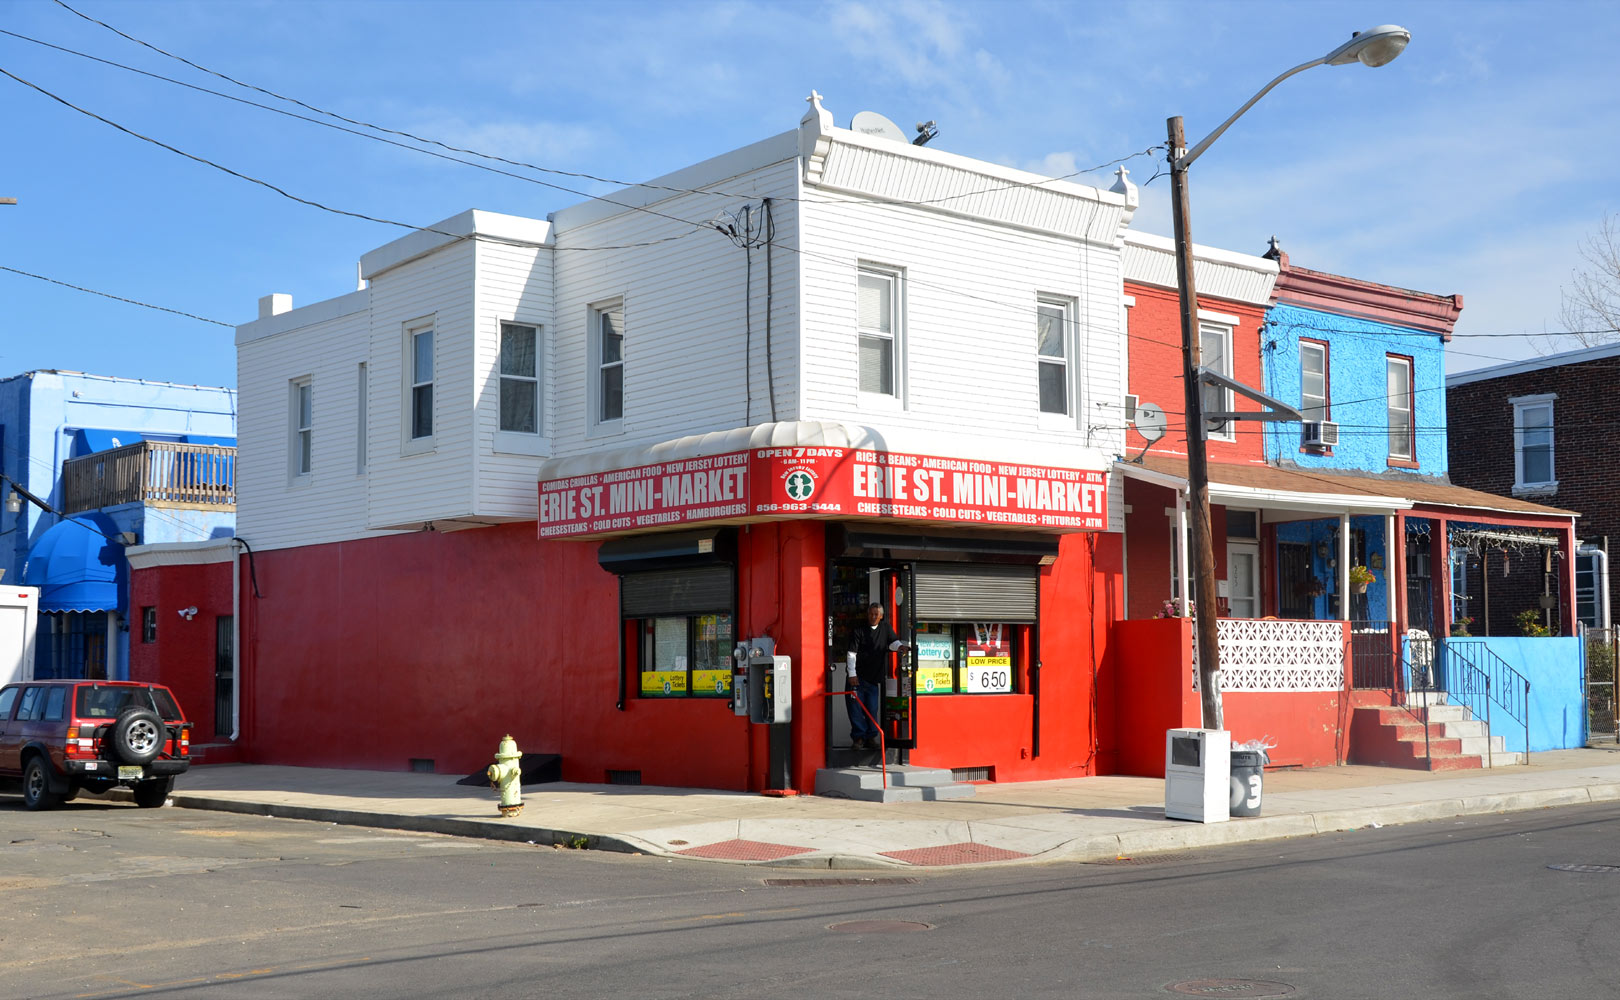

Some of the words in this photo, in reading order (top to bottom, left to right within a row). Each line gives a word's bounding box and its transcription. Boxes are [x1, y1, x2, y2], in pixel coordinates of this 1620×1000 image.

[757, 449, 793, 458] OPEN
[793, 447, 806, 458] 7
[807, 448, 843, 458] DAYS
[856, 451, 877, 463] RICE
[879, 455, 886, 464] &
[888, 455, 917, 467] BEANS
[922, 457, 968, 472] AMERICAN
[969, 462, 992, 474] FOOD
[998, 465, 1017, 476] NEW
[1018, 467, 1046, 478] JERSEY
[1047, 470, 1080, 481] LOTTERY
[1086, 472, 1103, 483] ATM
[542, 480, 569, 492] COMIDAS
[570, 476, 598, 488] CRIOLLAS
[603, 469, 641, 484] AMERICAN
[642, 465, 661, 478] FOOD
[666, 462, 684, 473] NEW
[685, 457, 712, 472] JERSEY
[713, 452, 748, 467] LOTTERY
[540, 490, 576, 524] ERIE
[580, 486, 606, 519] ST.
[610, 466, 747, 515] MINI-MARKET
[853, 463, 907, 500] ERIE
[913, 468, 948, 503] ST.
[953, 472, 1105, 514] MINI-MARKET
[540, 522, 588, 537] CHEESESTEAKS
[593, 519, 611, 531] COLD
[612, 516, 631, 529] CUTS
[636, 512, 681, 526] VEGETABLES
[686, 503, 747, 520] HAMBURGUERS
[756, 503, 841, 512] 856-963-5444
[857, 502, 927, 517] CHEESESTEAKS
[933, 506, 957, 519] COLD
[957, 508, 982, 520] CUTS
[986, 511, 1037, 524] VEGETABLES
[1041, 515, 1081, 527] FRITURAS
[1085, 518, 1102, 528] ATM
[917, 638, 931, 647] New
[918, 648, 942, 658] Lottery
